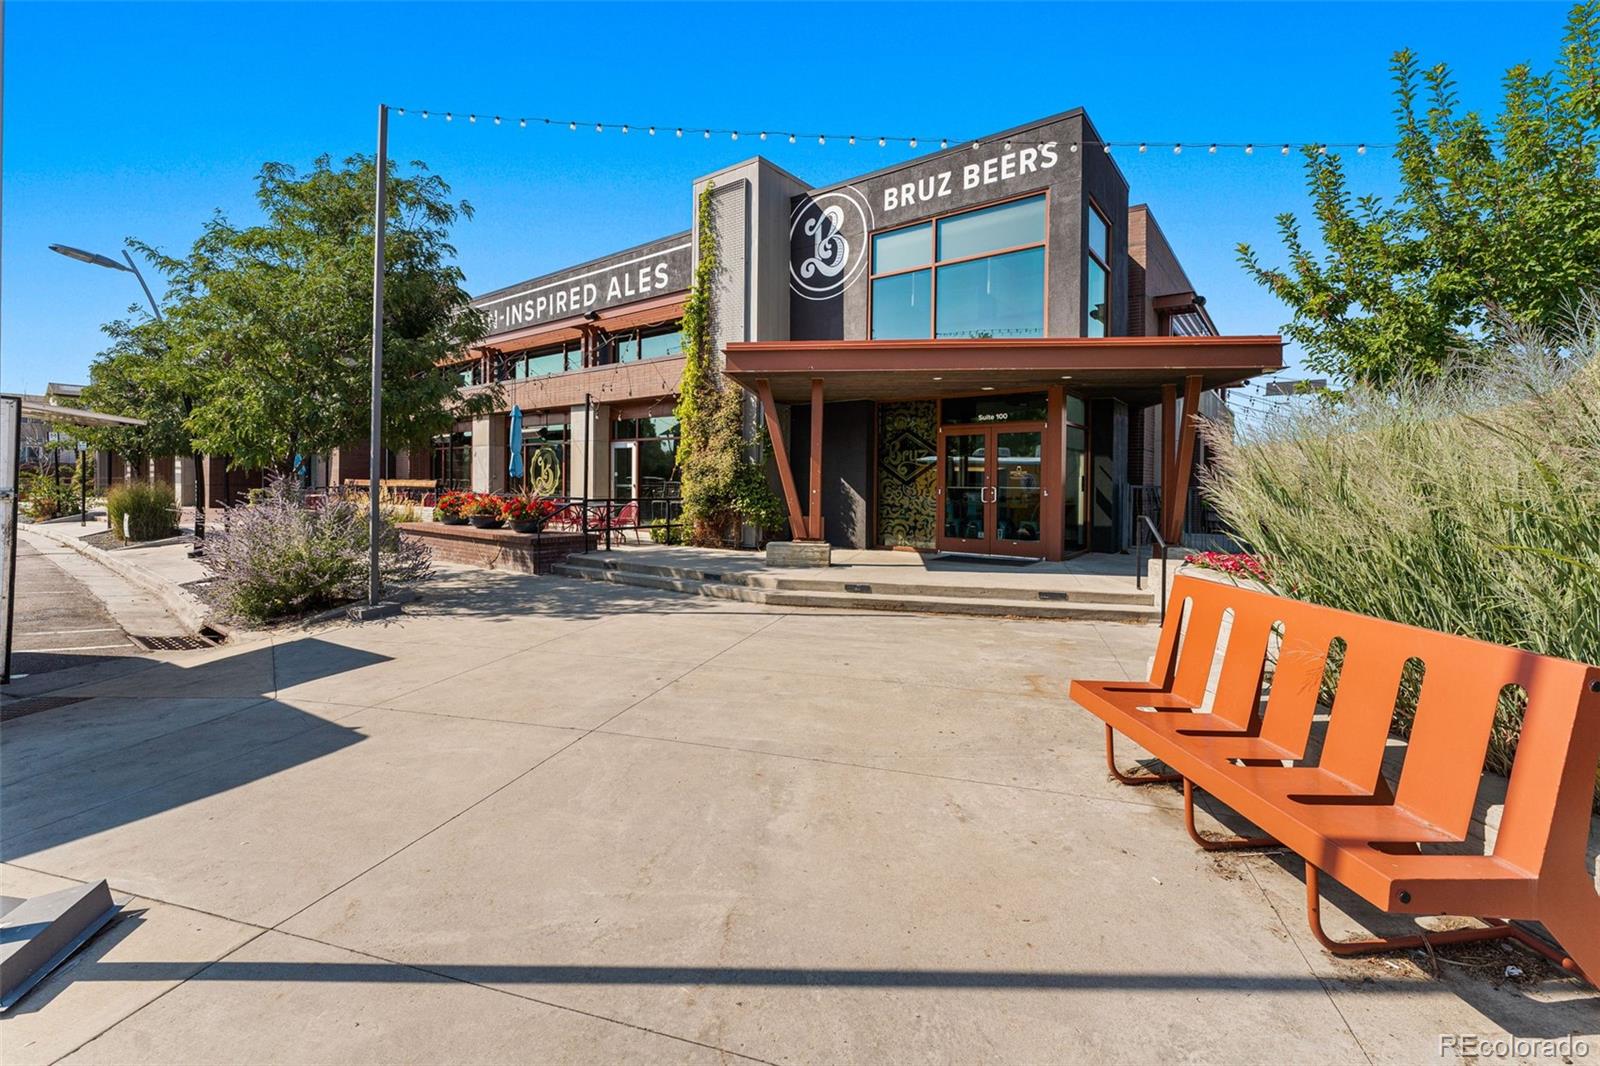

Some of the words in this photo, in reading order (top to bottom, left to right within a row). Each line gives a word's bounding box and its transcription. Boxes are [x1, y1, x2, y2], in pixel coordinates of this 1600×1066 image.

[883, 171, 952, 211] BRUZ
[963, 141, 1059, 190] BEERS
[480, 283, 597, 329] N-INSPIRED
[607, 263, 668, 300] ALES
[995, 412, 1008, 420] 100
